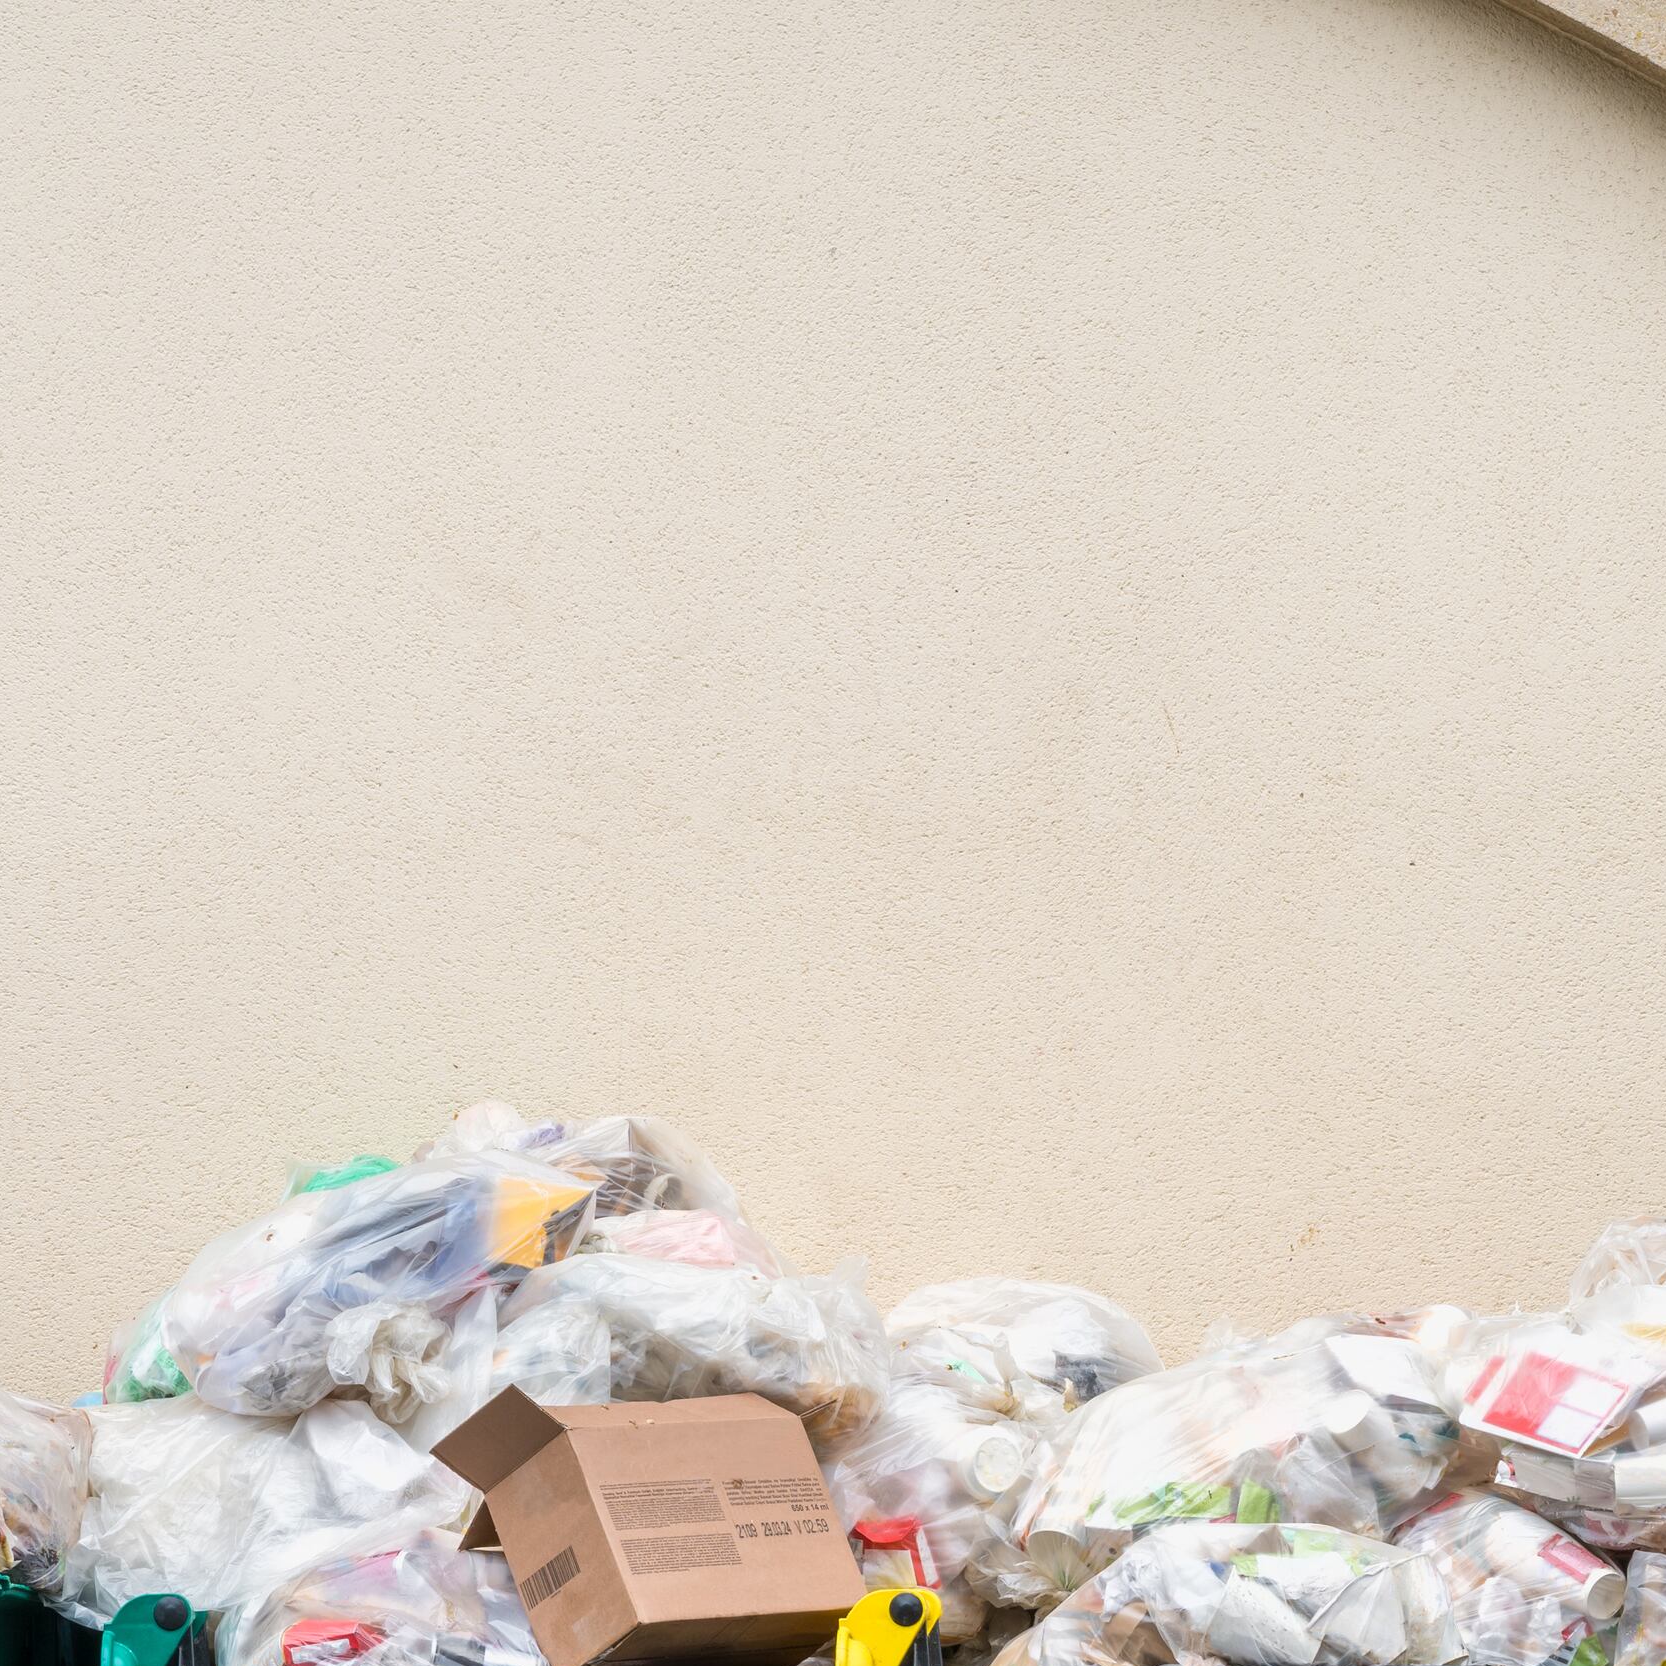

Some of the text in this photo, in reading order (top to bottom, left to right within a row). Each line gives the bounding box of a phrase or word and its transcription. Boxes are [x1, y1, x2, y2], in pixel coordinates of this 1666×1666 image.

[735, 1523, 758, 1538] 2109
[761, 1521, 792, 1537] 29.03.24
[794, 1519, 802, 1534] V
